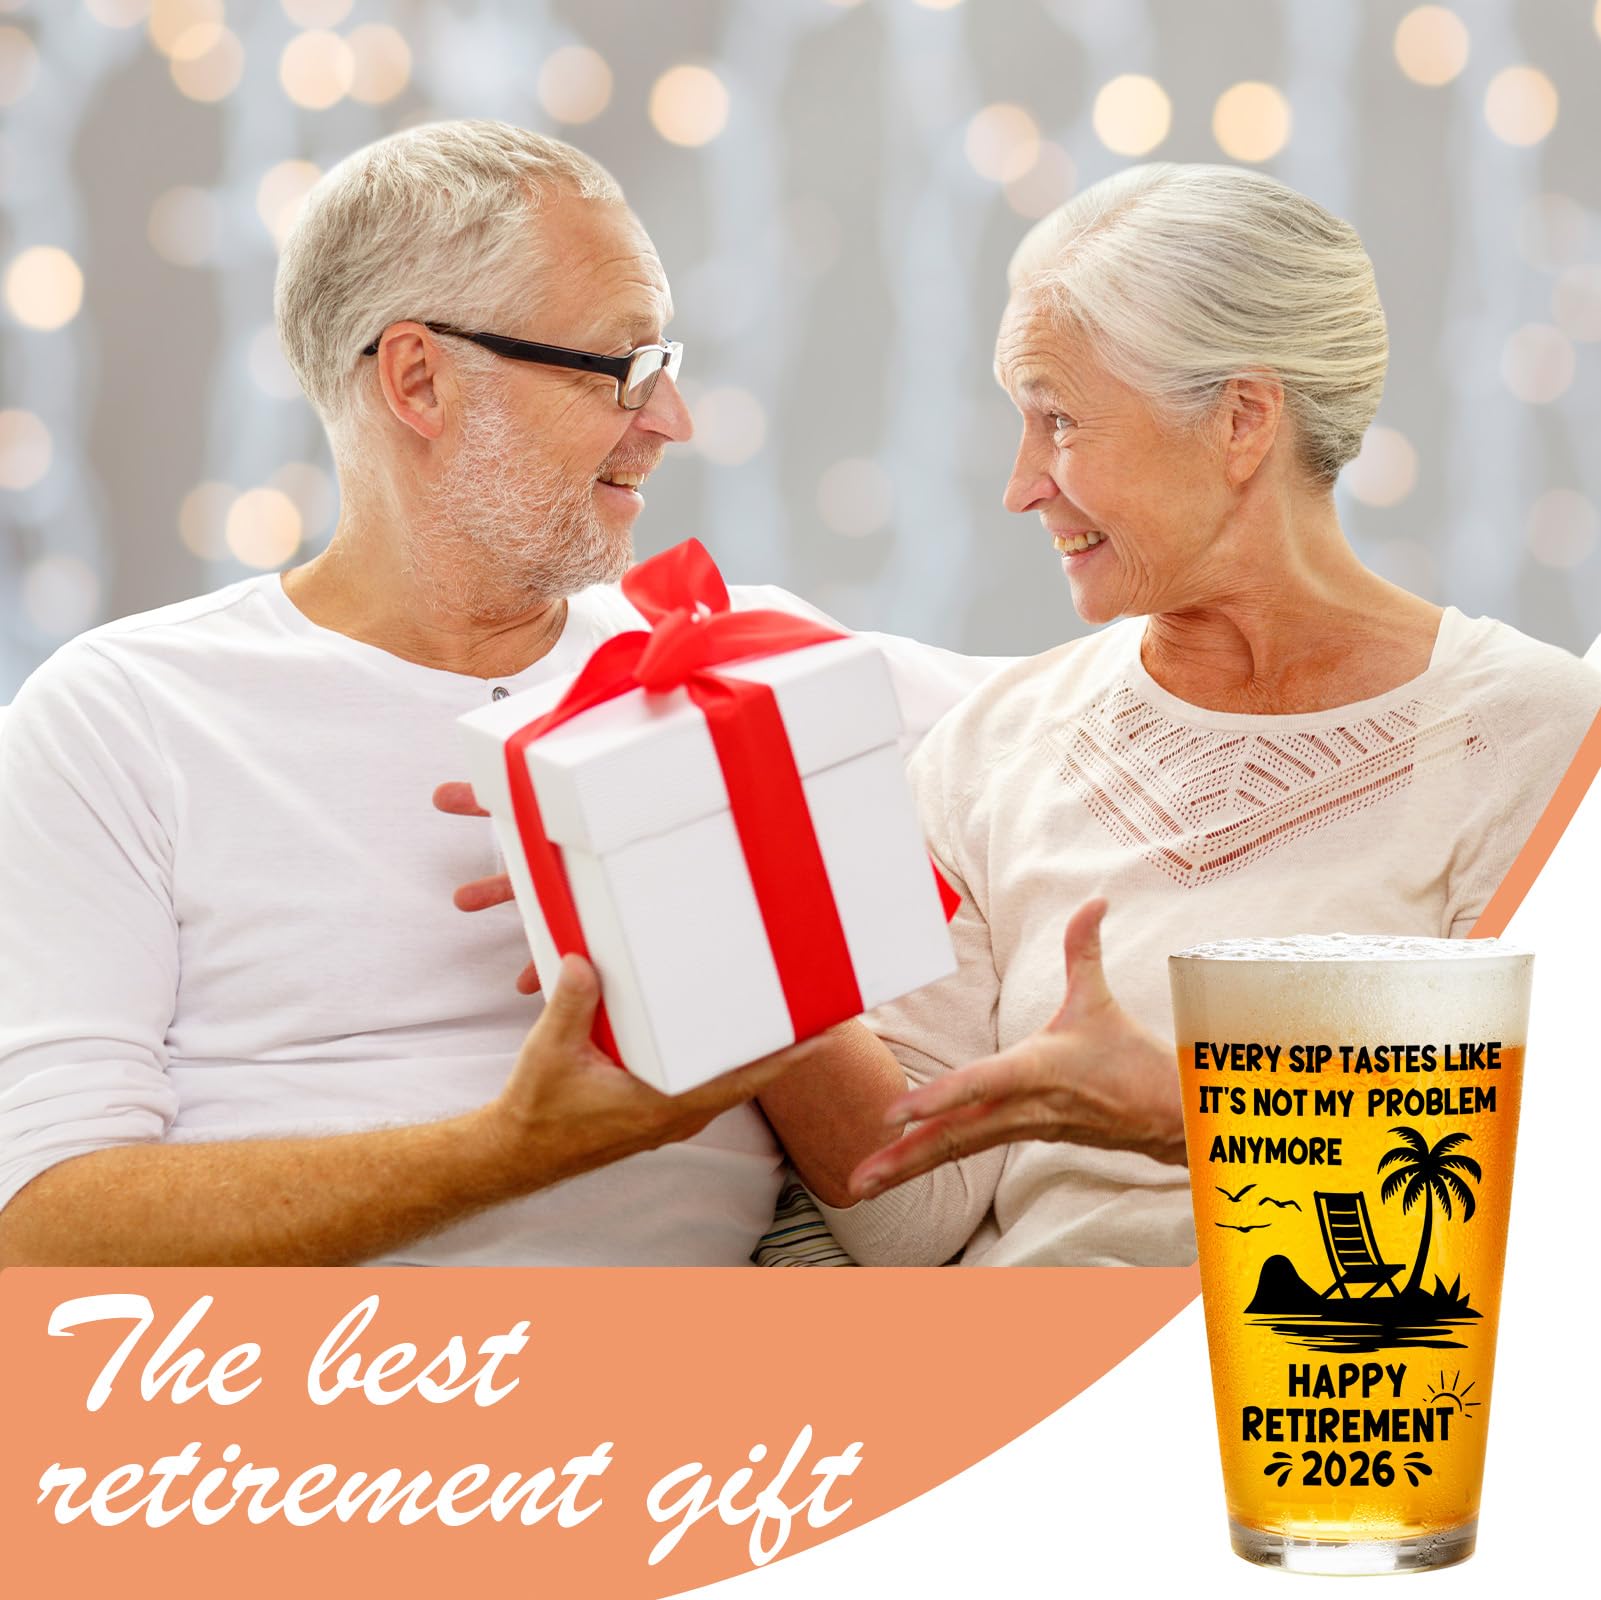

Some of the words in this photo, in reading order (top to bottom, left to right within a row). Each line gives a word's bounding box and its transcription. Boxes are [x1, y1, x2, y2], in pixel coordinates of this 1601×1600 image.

[1194, 1041, 1282, 1073] EVERY
[1288, 1044, 1333, 1073] SIP
[1339, 1044, 1437, 1074] TASTES
[1444, 1041, 1502, 1072] LIKE
[1199, 1085, 1246, 1115] IT'S
[1253, 1087, 1308, 1117] NOT
[1314, 1089, 1355, 1118] MY
[1368, 1086, 1496, 1117] PROBLEM
[1208, 1135, 1342, 1166] ANYMORE
[1288, 1362, 1407, 1399] HAPPY
[1242, 1405, 1454, 1443] RETIREMENT
[1301, 1450, 1395, 1488] 2026
